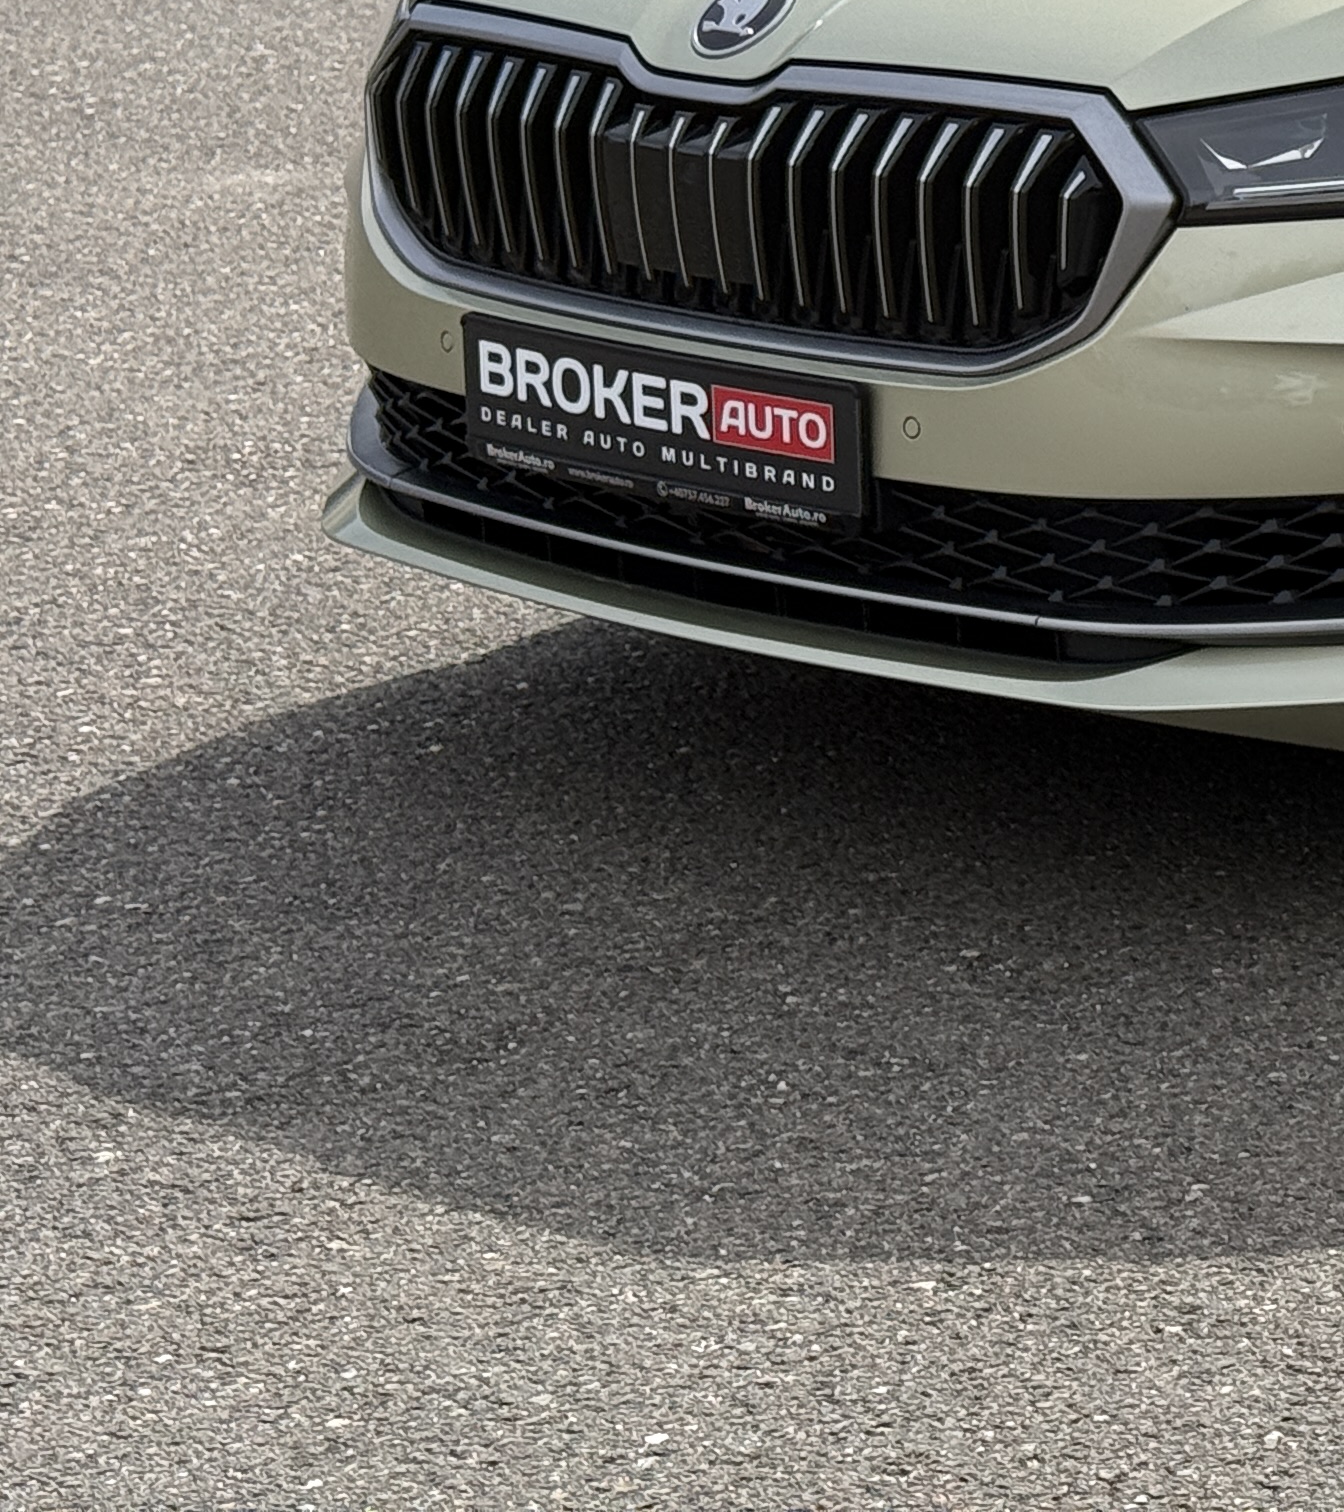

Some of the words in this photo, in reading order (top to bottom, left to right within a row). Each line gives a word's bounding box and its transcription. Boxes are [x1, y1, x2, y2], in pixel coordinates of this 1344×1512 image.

[478, 339, 711, 441] BROKER
[720, 399, 828, 449] AUTO
[480, 406, 569, 441] DEALER
[583, 430, 646, 458] AUTO
[661, 445, 836, 492] MULTIBRAND
